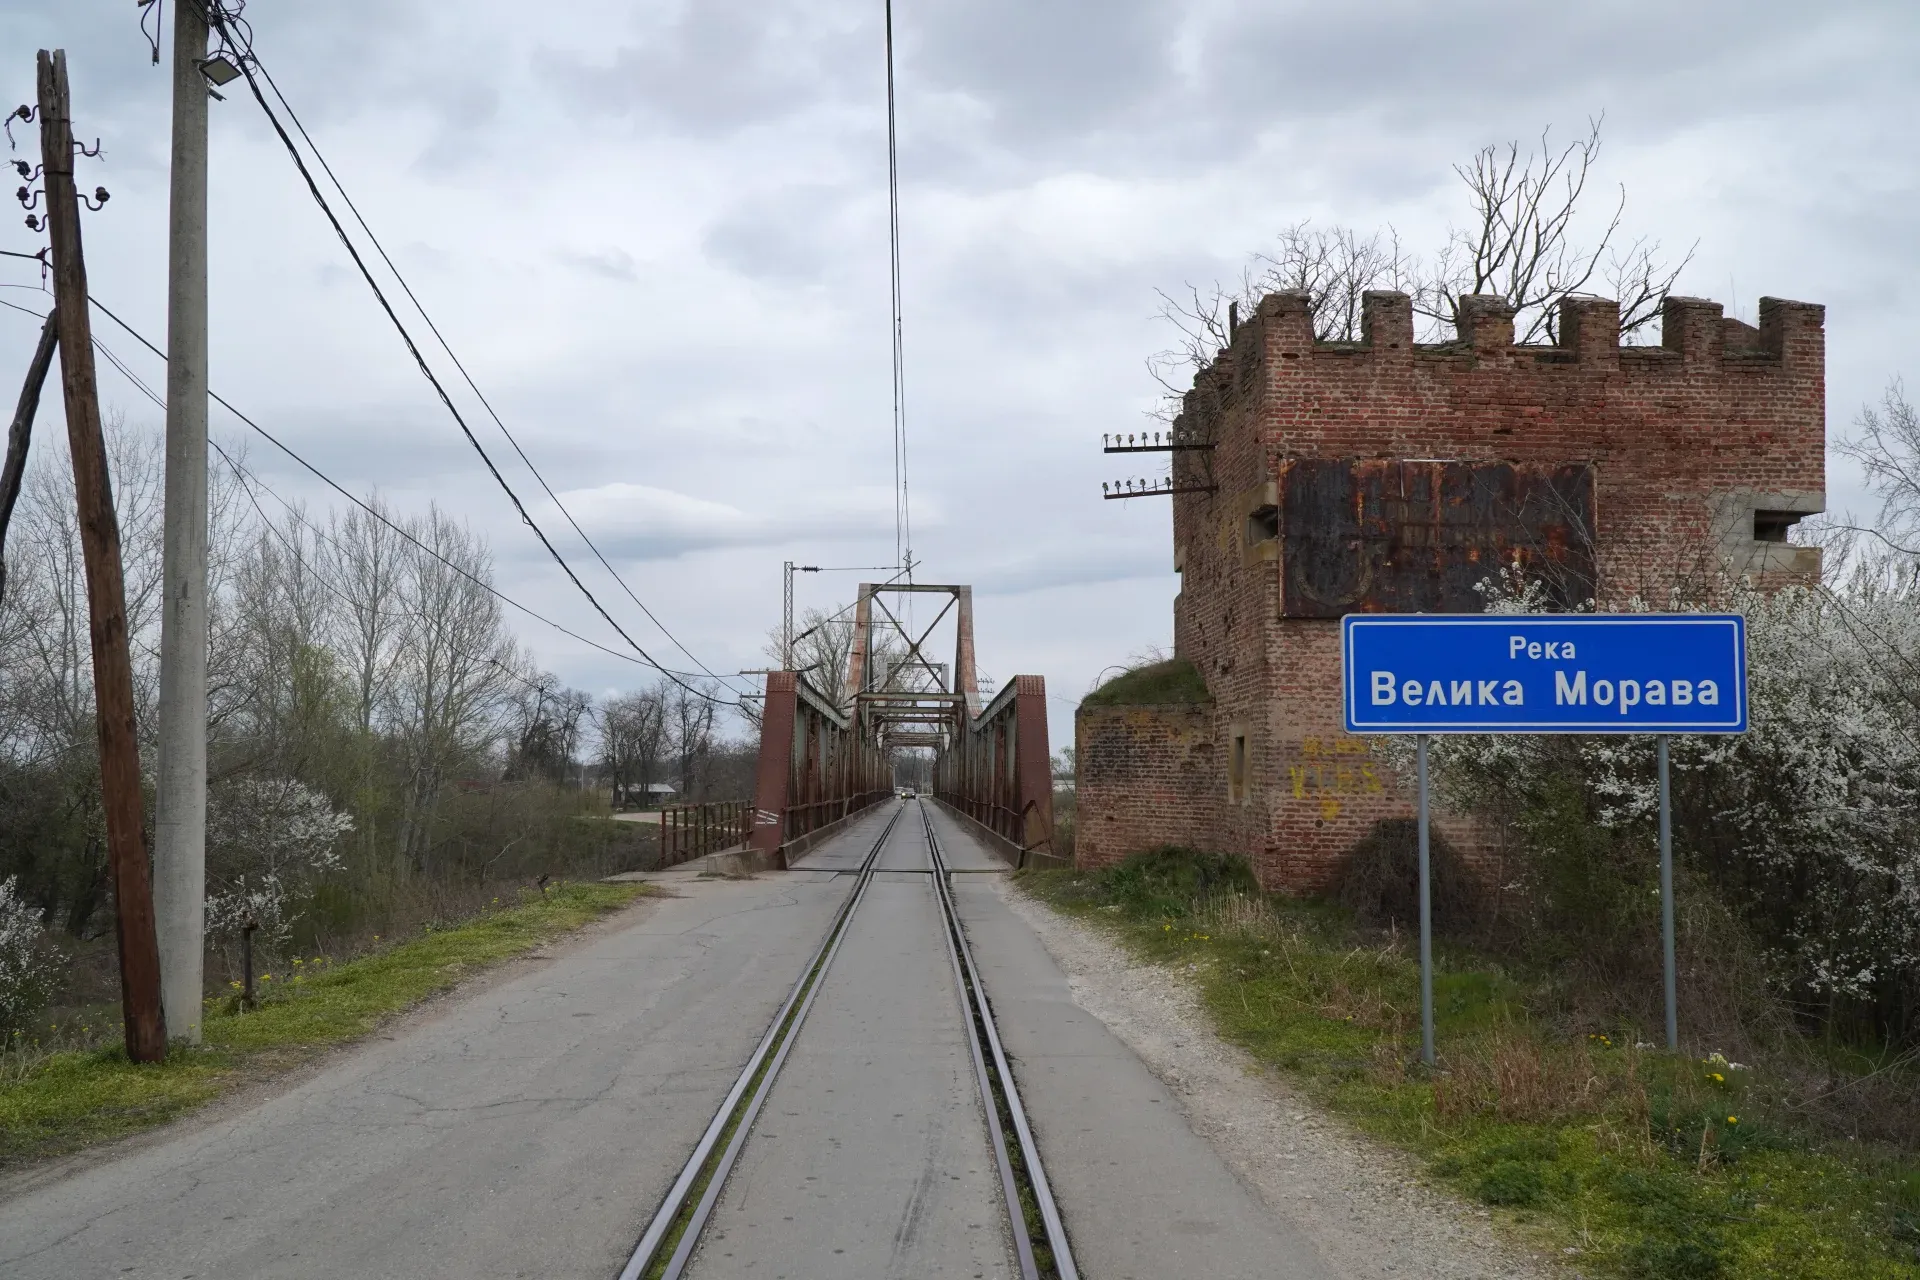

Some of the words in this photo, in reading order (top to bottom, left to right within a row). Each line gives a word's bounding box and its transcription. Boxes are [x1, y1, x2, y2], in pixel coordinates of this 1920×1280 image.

[1509, 636, 1575, 659] Река
[1371, 671, 1523, 705] Велика
[1555, 671, 1718, 713] Морава
